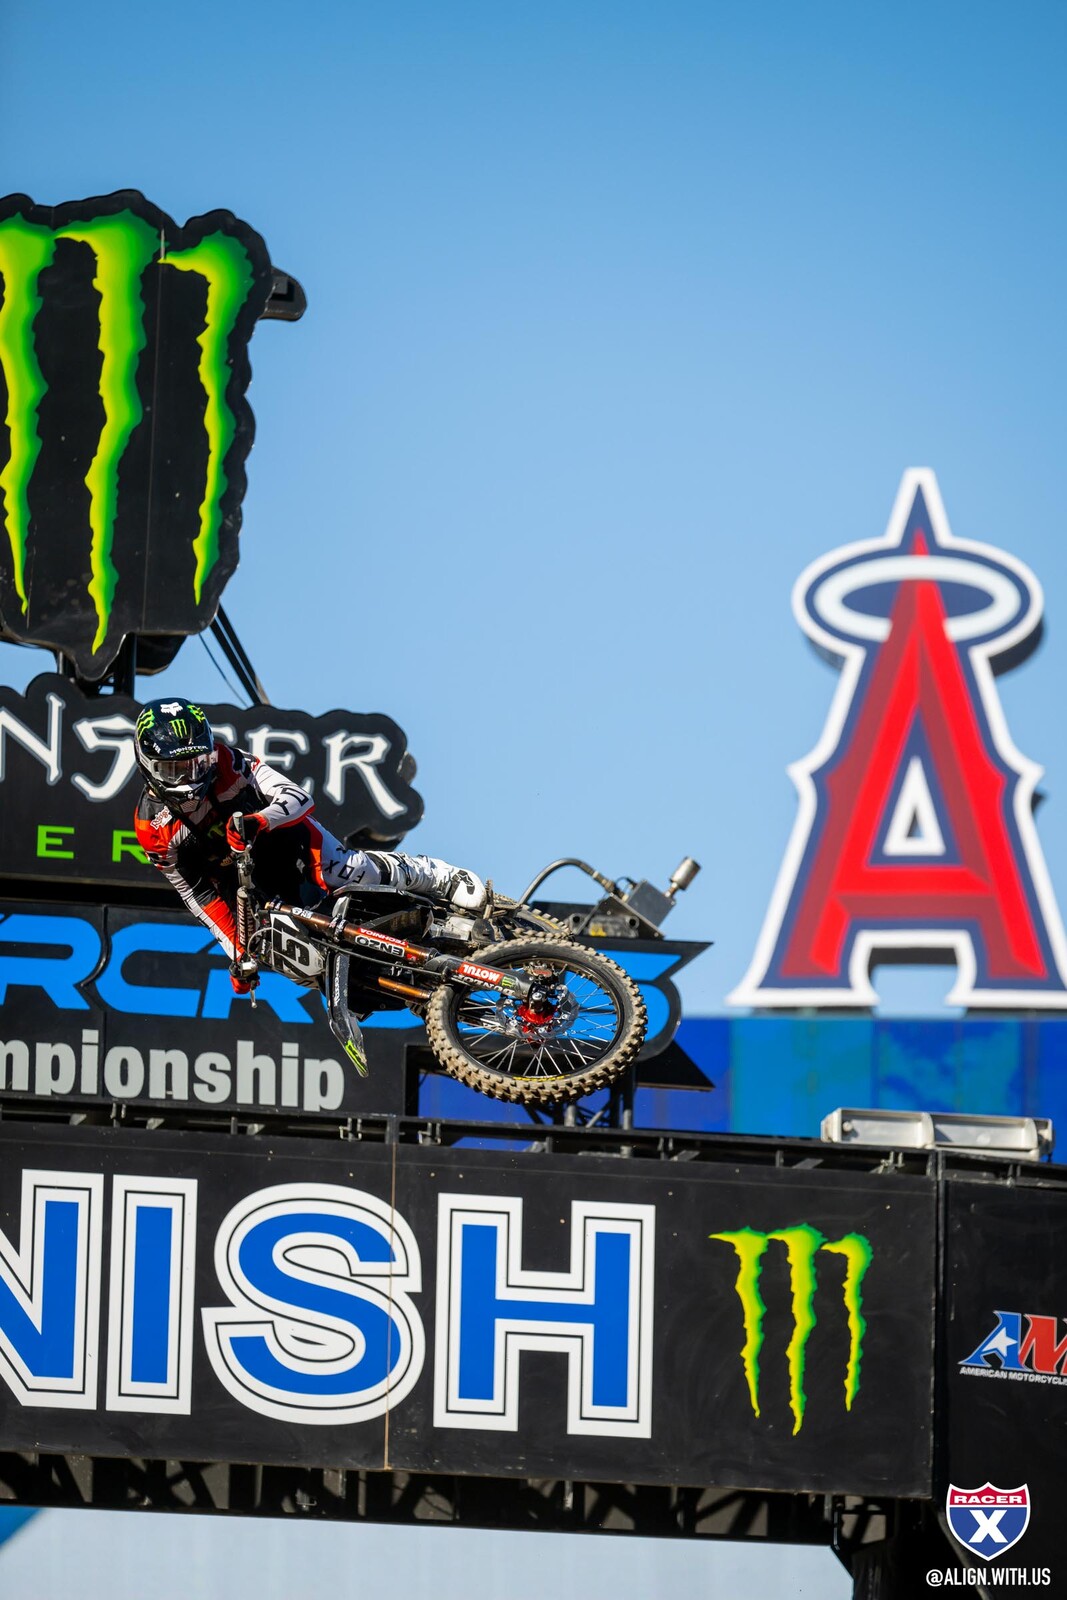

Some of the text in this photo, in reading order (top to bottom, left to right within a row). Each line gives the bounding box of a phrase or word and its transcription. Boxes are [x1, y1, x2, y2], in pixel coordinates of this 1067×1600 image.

[725, 467, 1067, 1005] A
[325, 860, 366, 884] FOX
[357, 936, 405, 957] ENZO
[359, 928, 408, 946] TECHNICA
[463, 964, 500, 982] MOTUL
[960, 1366, 1007, 1379] AMERICAN
